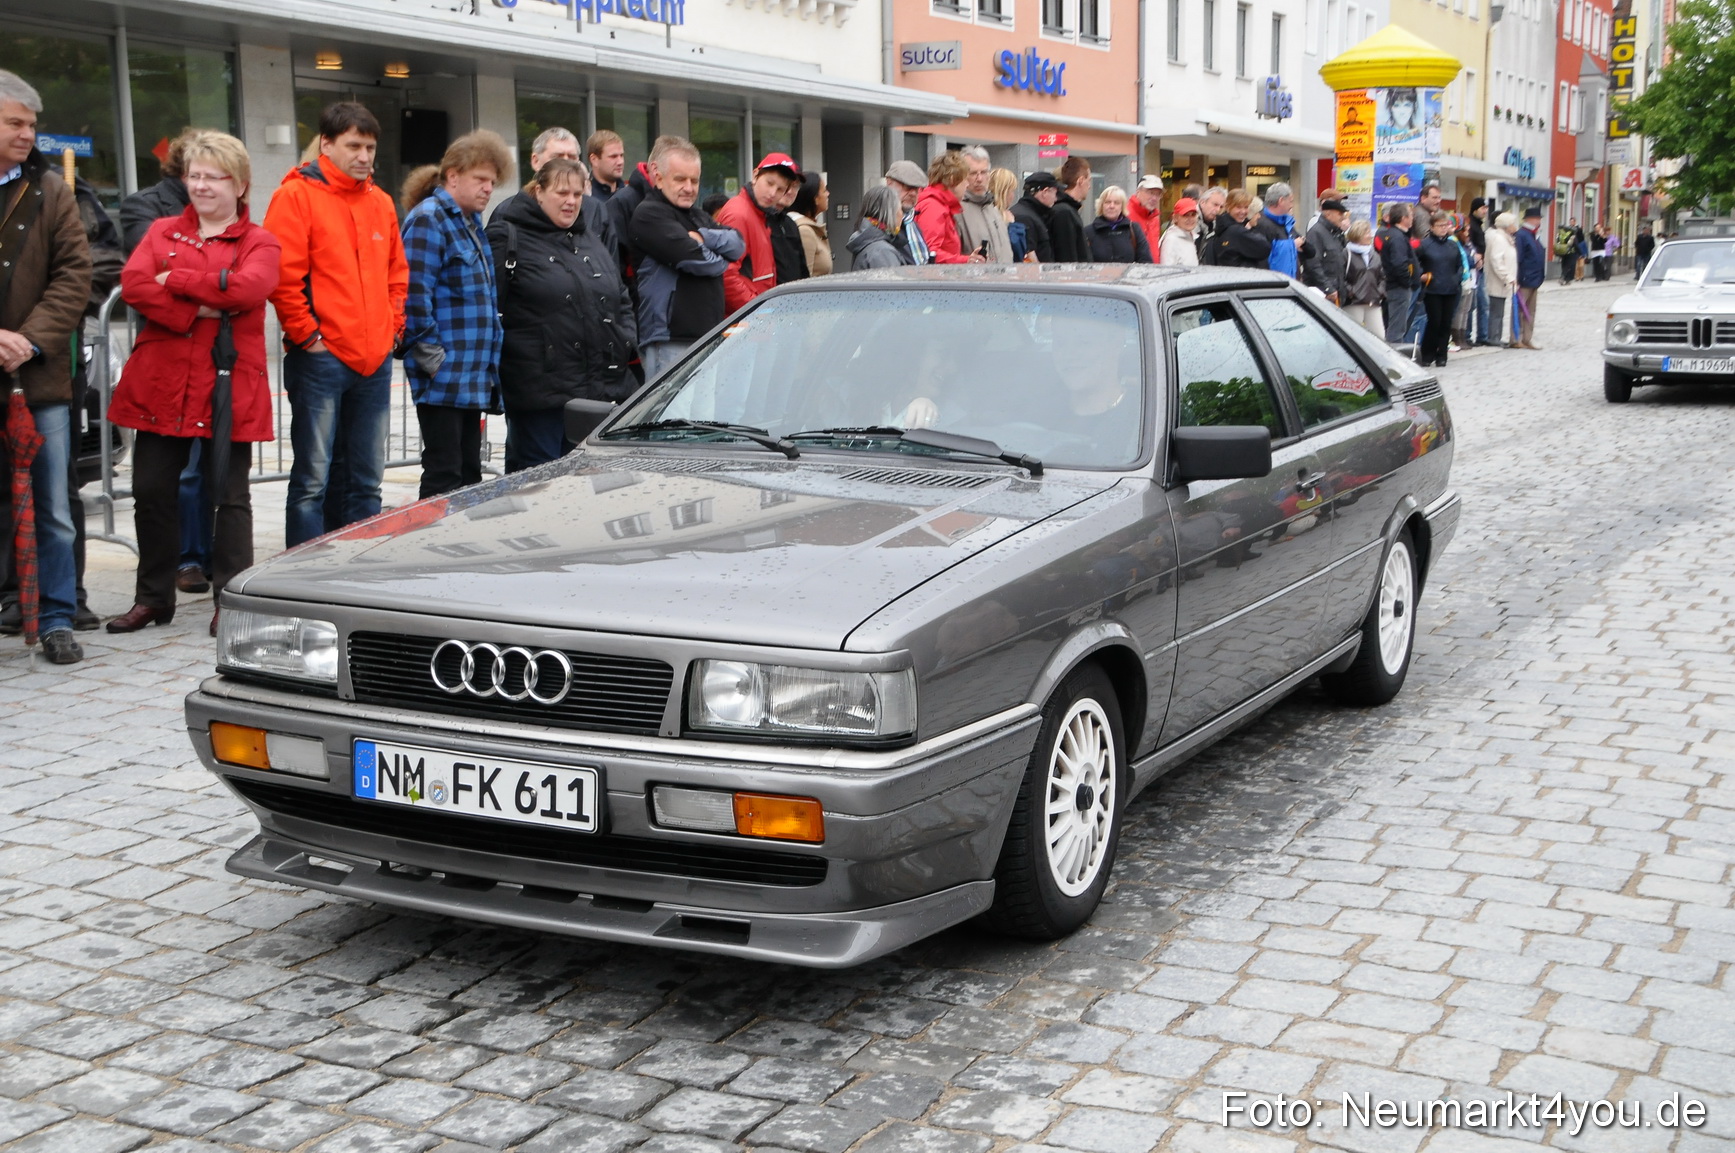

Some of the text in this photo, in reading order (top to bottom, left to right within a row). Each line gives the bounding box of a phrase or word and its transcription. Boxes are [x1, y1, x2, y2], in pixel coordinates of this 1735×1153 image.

[902, 46, 955, 65] sutor.
[997, 46, 1067, 96] sutor.
[1609, 17, 1635, 137] HOTEL
[1700, 360, 1734, 371] 1969H
[378, 750, 590, 823] NM FK 611
